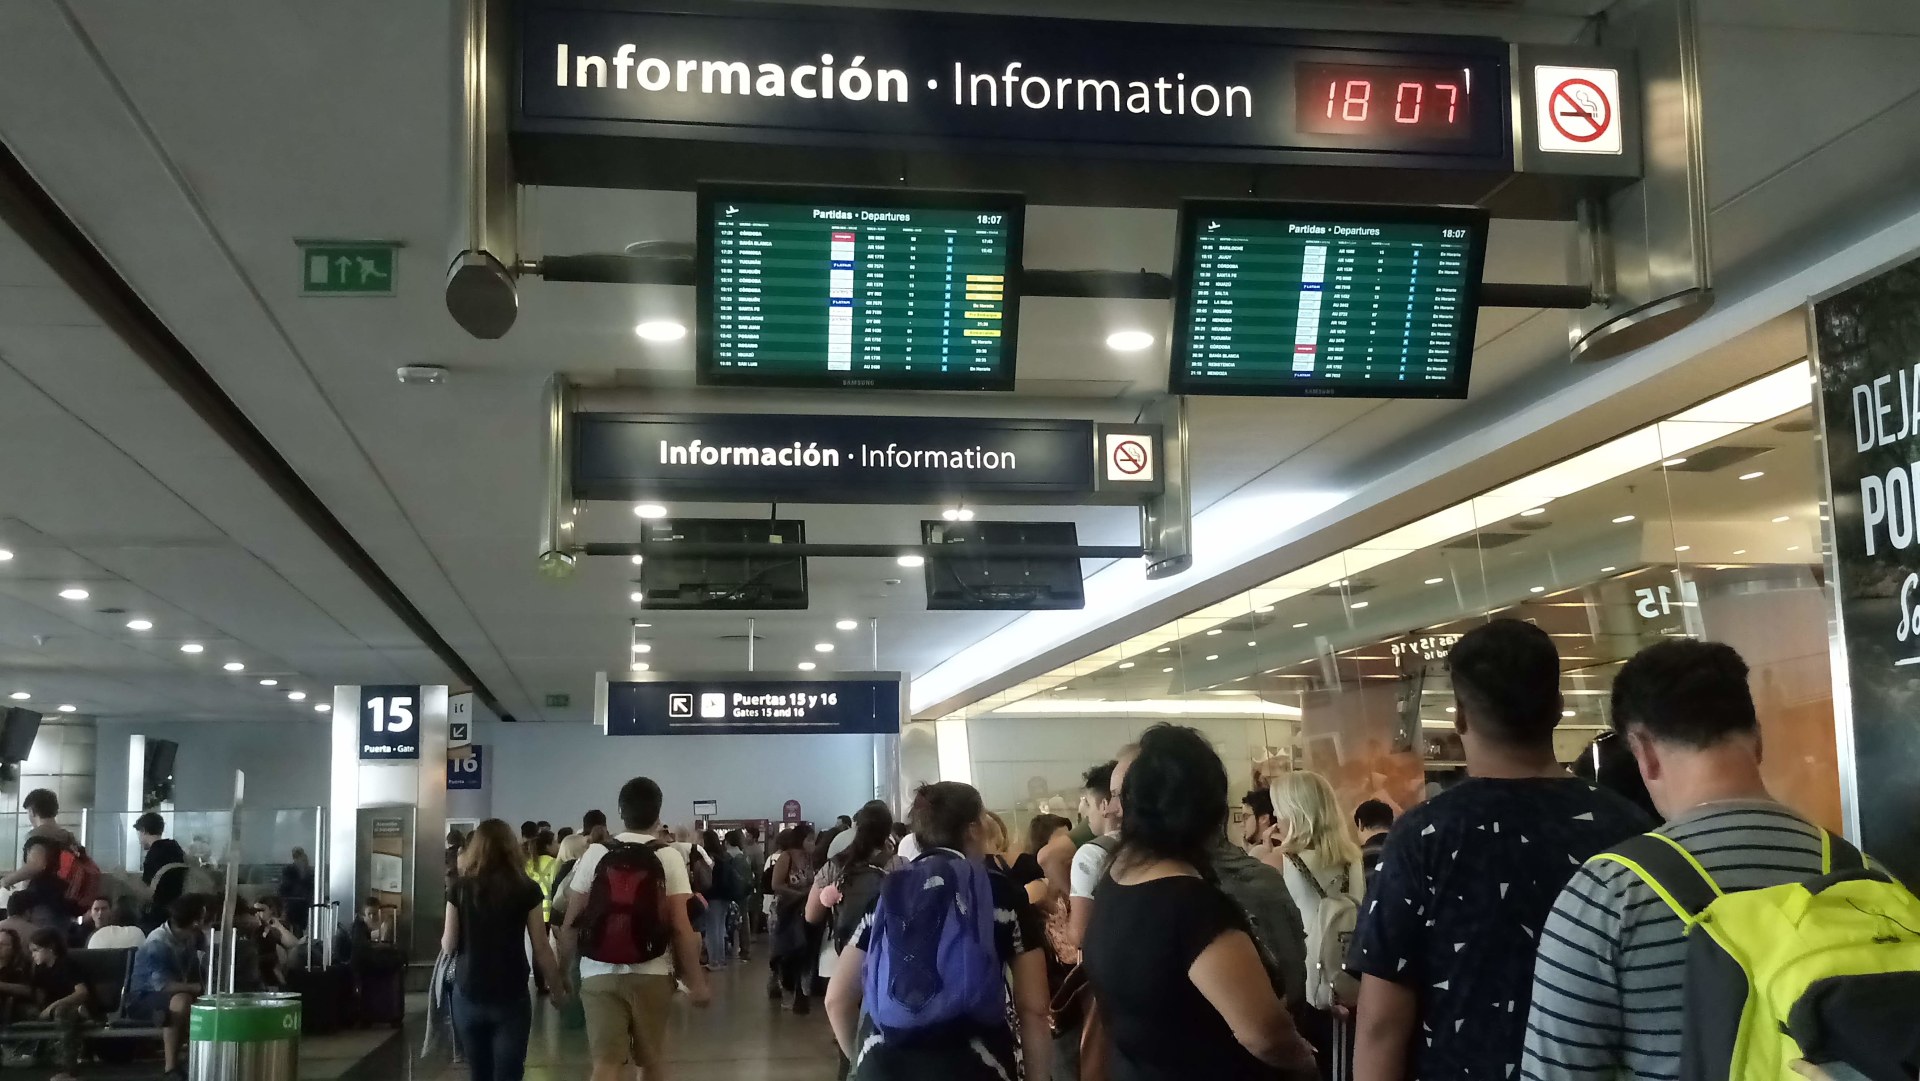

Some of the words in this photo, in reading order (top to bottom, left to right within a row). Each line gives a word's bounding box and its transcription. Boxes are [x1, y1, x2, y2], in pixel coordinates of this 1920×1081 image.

[556, 43, 909, 103] Información
[954, 61, 1254, 119] Information
[1326, 80, 1371, 121] 18
[1394, 82, 1457, 124] 07
[813, 209, 853, 219] Partidas
[860, 211, 911, 222] Departures
[976, 215, 1002, 224] 18:07
[1288, 224, 1326, 234] Partidas
[1333, 225, 1380, 236] Departures
[1441, 229, 1466, 238] 18:07
[660, 440, 838, 466] Información
[860, 444, 1016, 470] Information
[733, 692, 787, 706] Puertas
[789, 692, 806, 706] 15
[808, 695, 818, 709] y
[820, 692, 838, 706] 16
[367, 696, 414, 732] 15
[732, 708, 759, 718] Gates
[761, 708, 772, 718] 15
[773, 708, 791, 718] and
[793, 708, 805, 718] 16
[364, 745, 392, 753] Puerta
[396, 745, 415, 753] Gate
